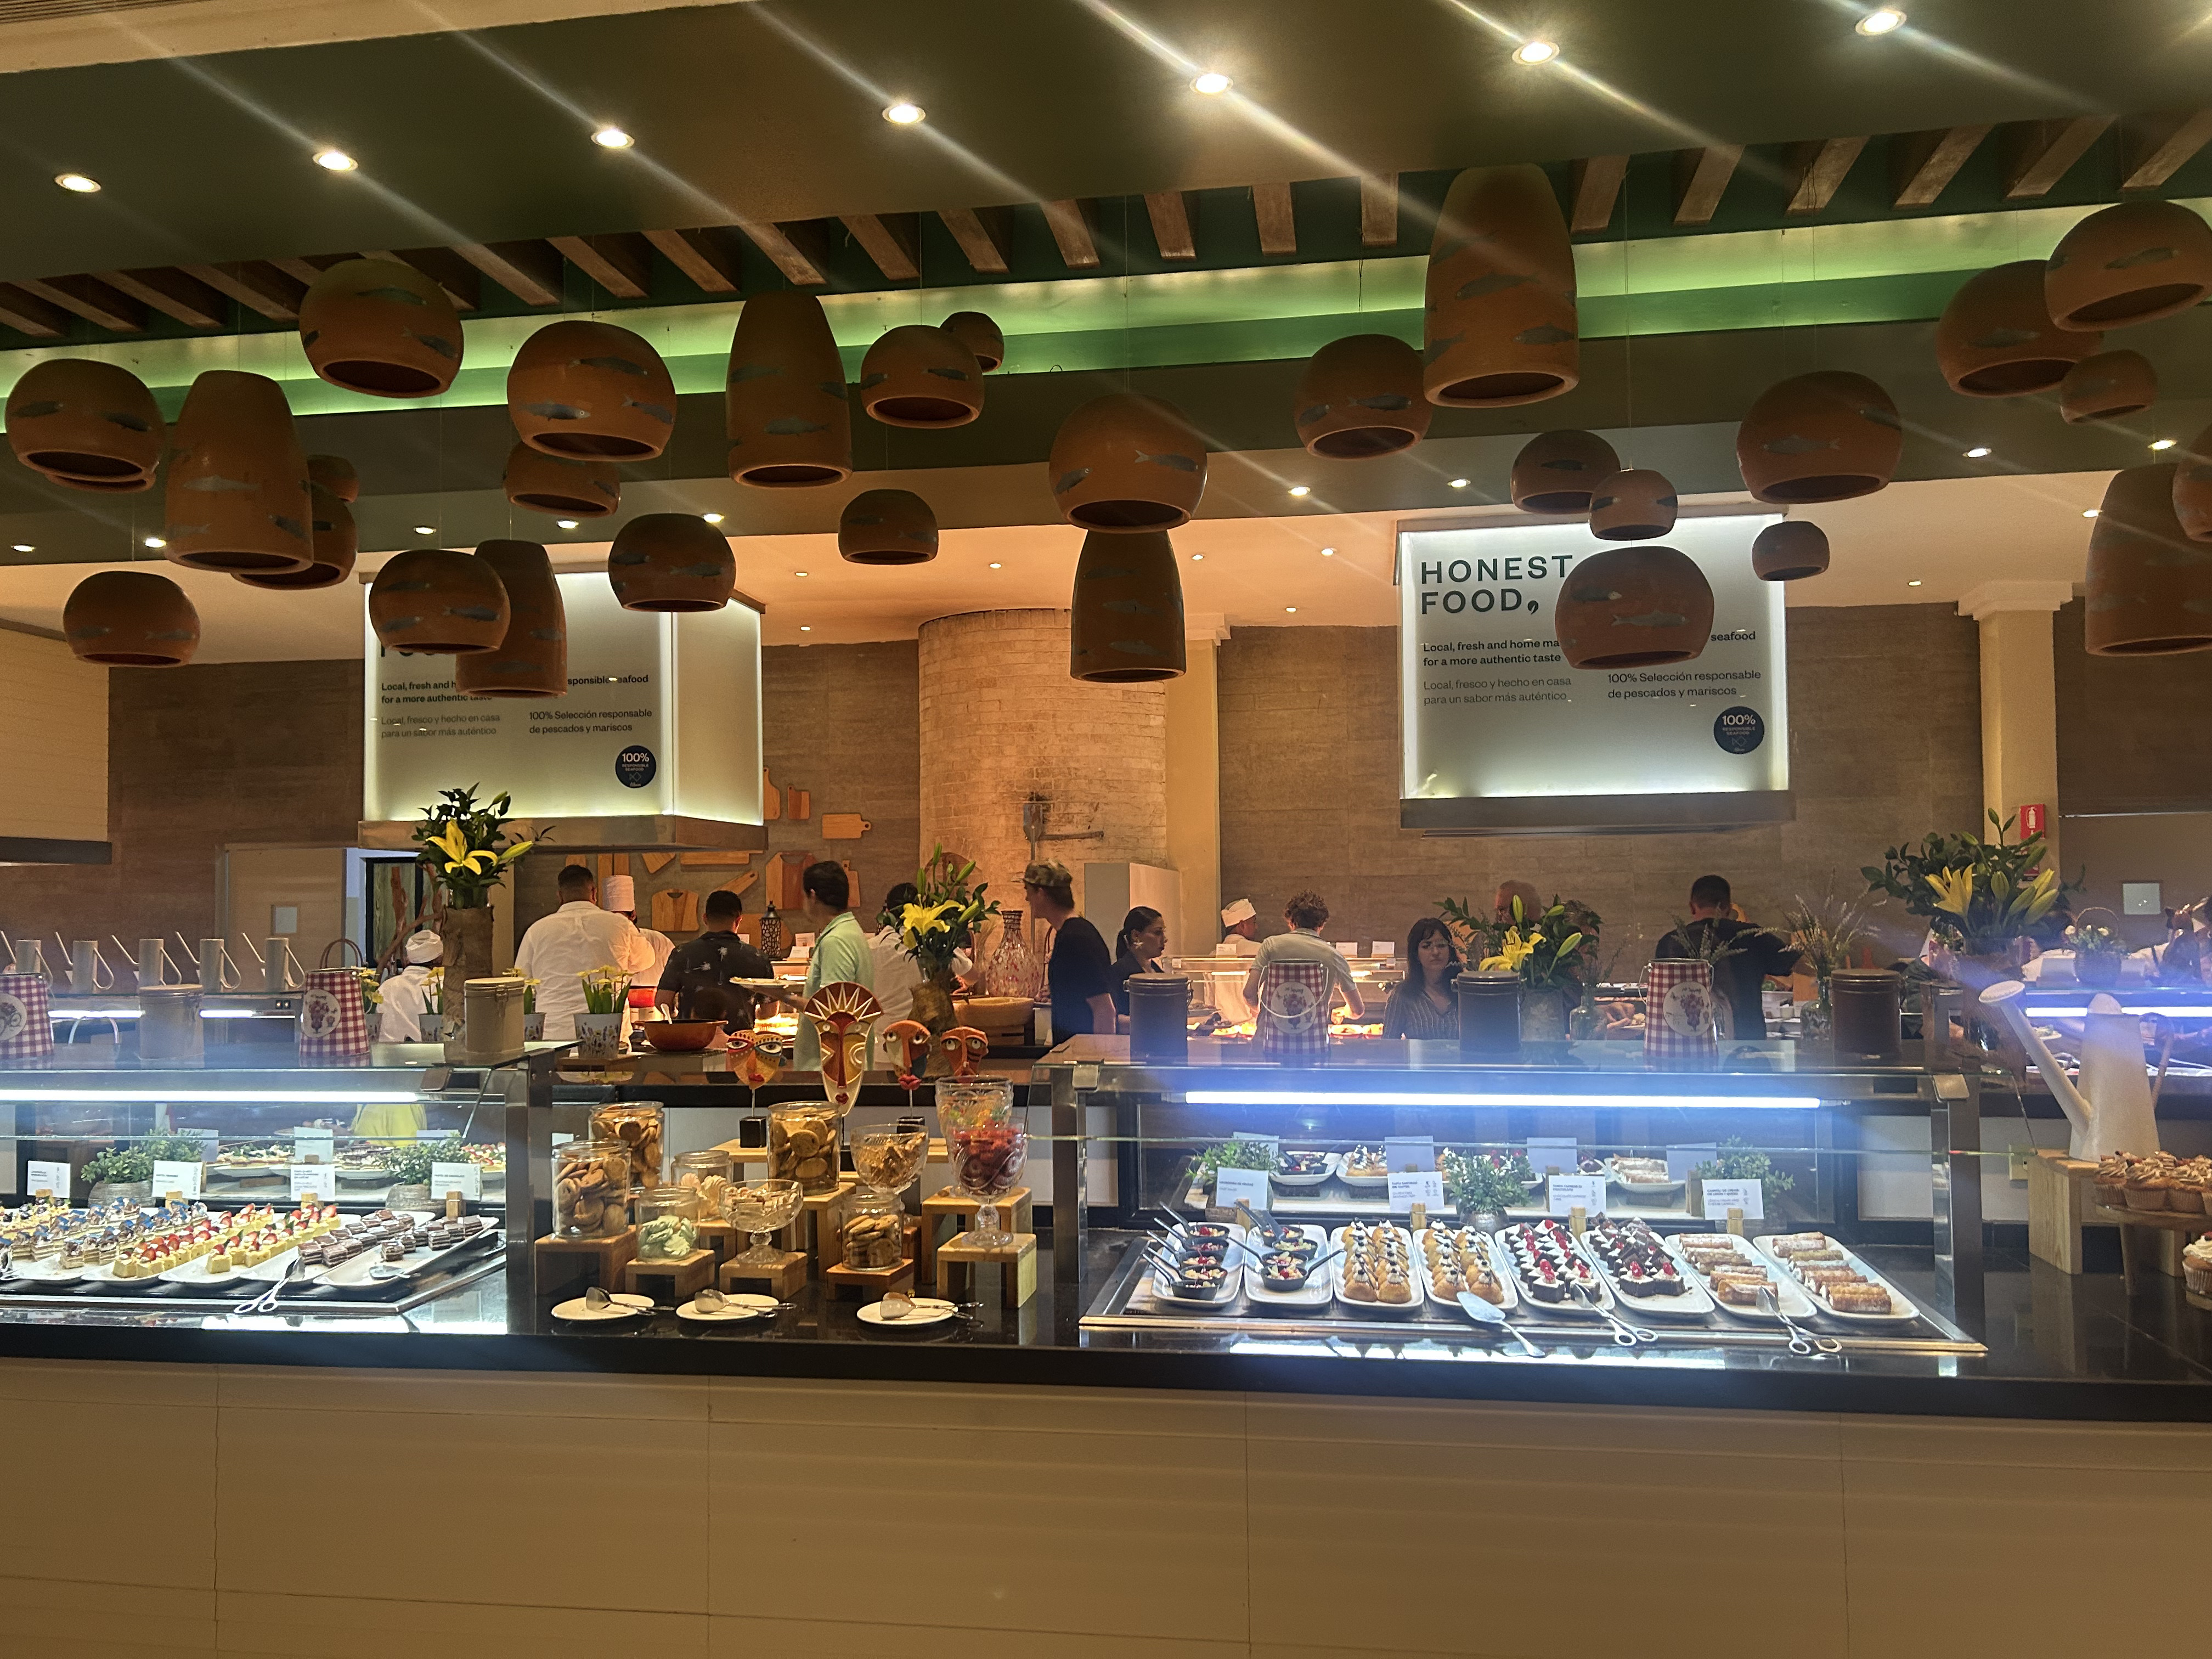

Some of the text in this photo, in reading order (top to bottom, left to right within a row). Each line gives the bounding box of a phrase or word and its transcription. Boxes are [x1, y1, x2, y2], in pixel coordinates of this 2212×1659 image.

[1421, 555, 1573, 584] HONEST
[1711, 631, 1756, 641] seafood
[1423, 642, 1455, 652] Local,
[1458, 641, 1485, 651] fresh
[1487, 640, 1507, 649] and
[1510, 640, 1541, 648] home
[1423, 657, 1438, 666] for
[1480, 654, 1531, 664] authentic
[1533, 654, 1561, 662] taste
[568, 676, 610, 686] sponsible
[1608, 670, 1761, 683] 100% Selección responsable
[381, 682, 407, 691] Local,
[409, 681, 431, 690] fresh
[433, 680, 449, 689] and
[1424, 681, 1454, 690] Local,
[1455, 679, 1487, 689] fresco
[1489, 681, 1496, 689] y
[1498, 678, 1530, 687] hecho
[1424, 697, 1447, 706] para
[1464, 693, 1493, 703] sabor
[1495, 692, 1516, 702] más
[1519, 691, 1567, 702] auténtico
[1608, 687, 1736, 699] de pescados y mariscos
[381, 695, 394, 704] for
[427, 694, 468, 702] authentic
[381, 716, 405, 725] Local,
[407, 715, 433, 724] fresco
[441, 714, 466, 723] hecho
[529, 709, 652, 720] 100% Selección responsable
[1722, 714, 1756, 725] 100%
[381, 731, 400, 739] para
[414, 728, 436, 737] sabor
[438, 727, 456, 736] más
[542, 724, 584, 735] pescados
[593, 724, 633, 732] mariscos
[622, 753, 650, 762] 100%
